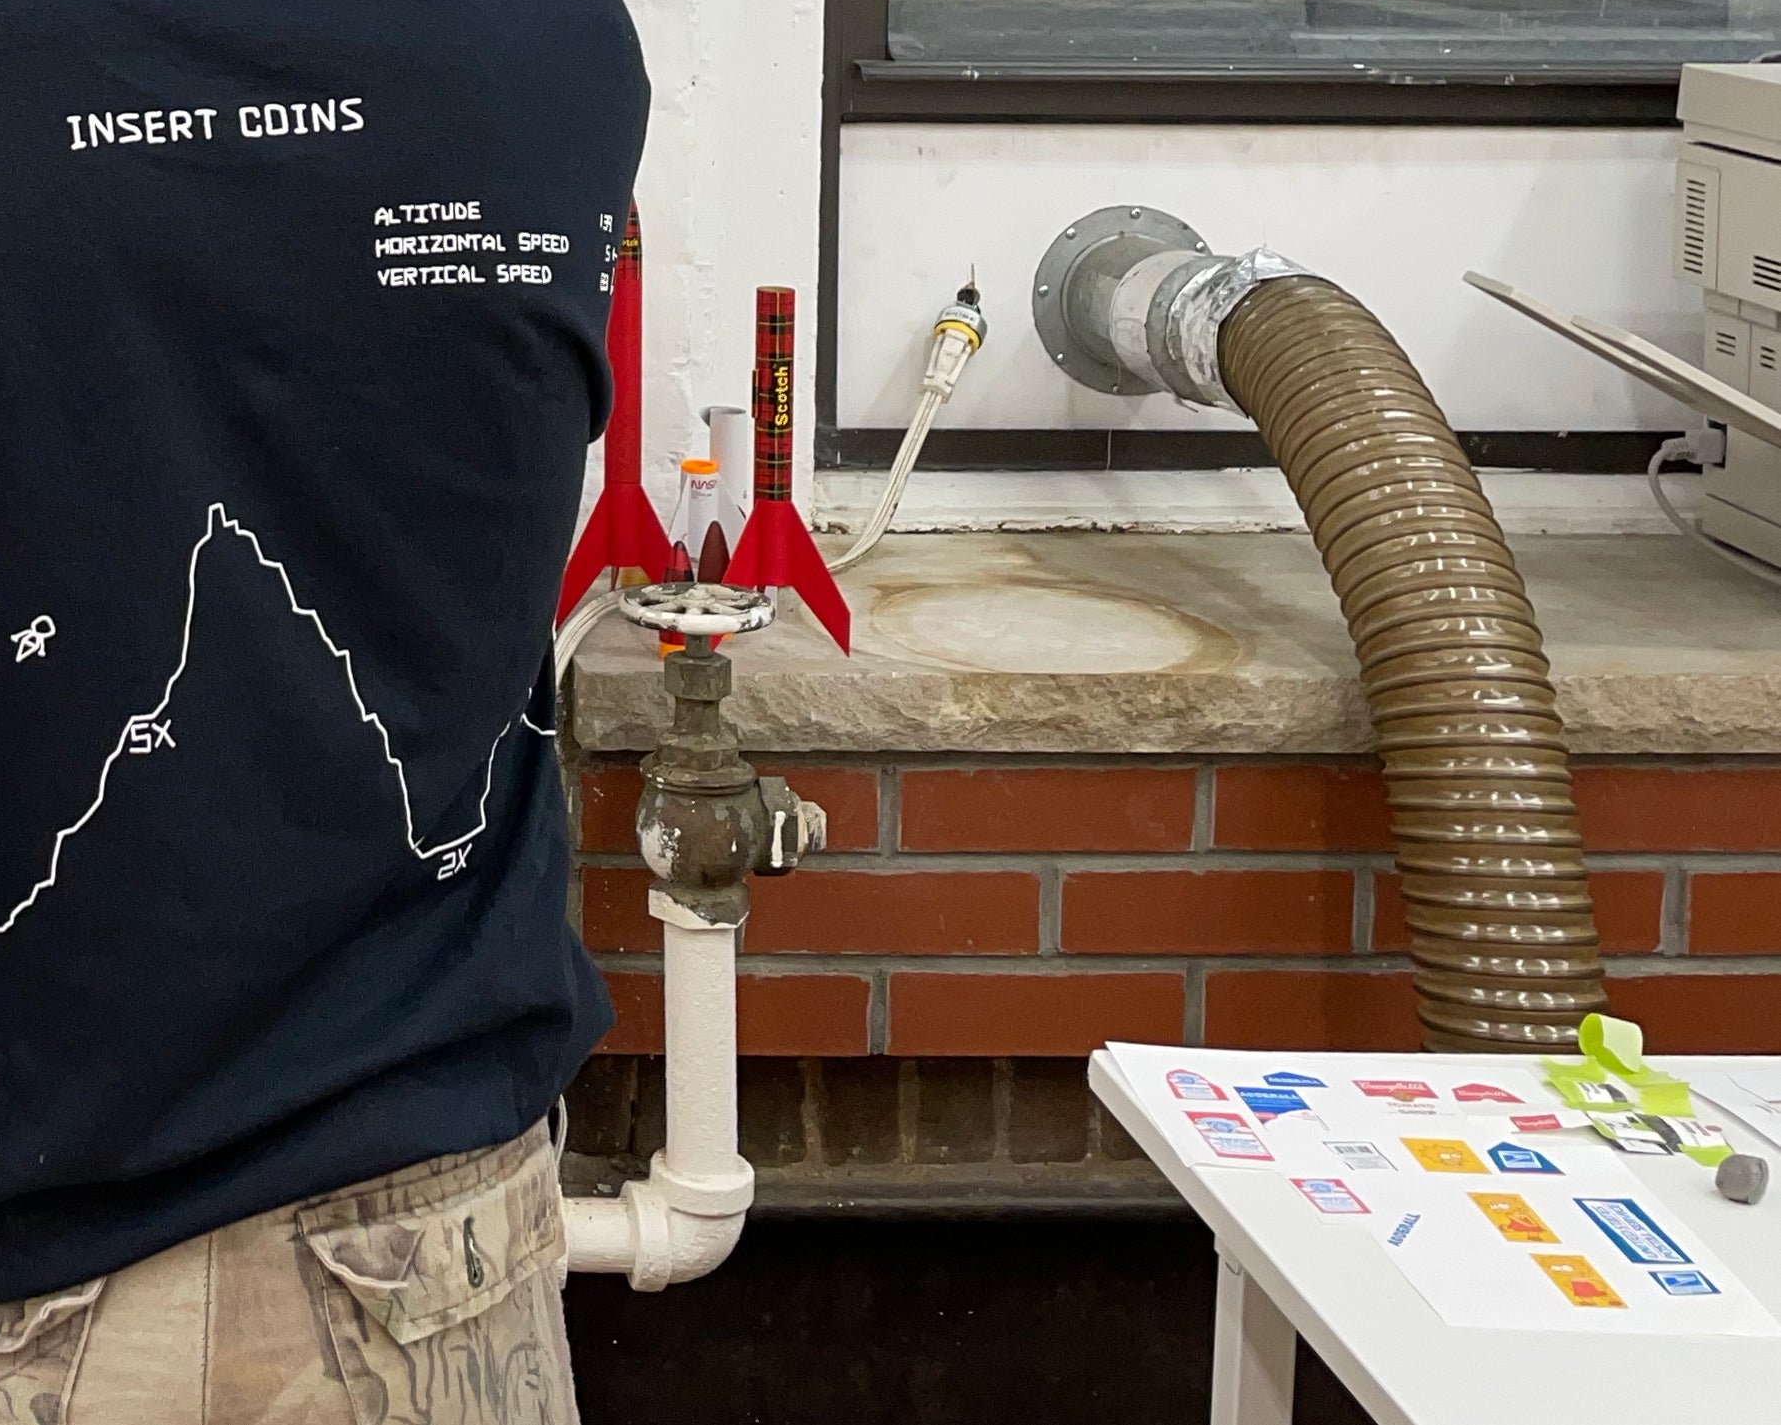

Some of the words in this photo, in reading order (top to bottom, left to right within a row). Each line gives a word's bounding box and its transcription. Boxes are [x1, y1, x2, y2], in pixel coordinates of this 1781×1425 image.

[66, 109, 218, 151] INSERT
[238, 98, 365, 139] COINS
[374, 201, 482, 226] ALTITUDE
[375, 233, 506, 258] HORIZONTAL
[518, 232, 570, 254] SPEED
[377, 264, 485, 287] VERTICAL
[496, 264, 553, 284] SPEED
[775, 365, 789, 428] Scotch
[129, 719, 177, 755] 5X
[437, 843, 473, 881] 2X
